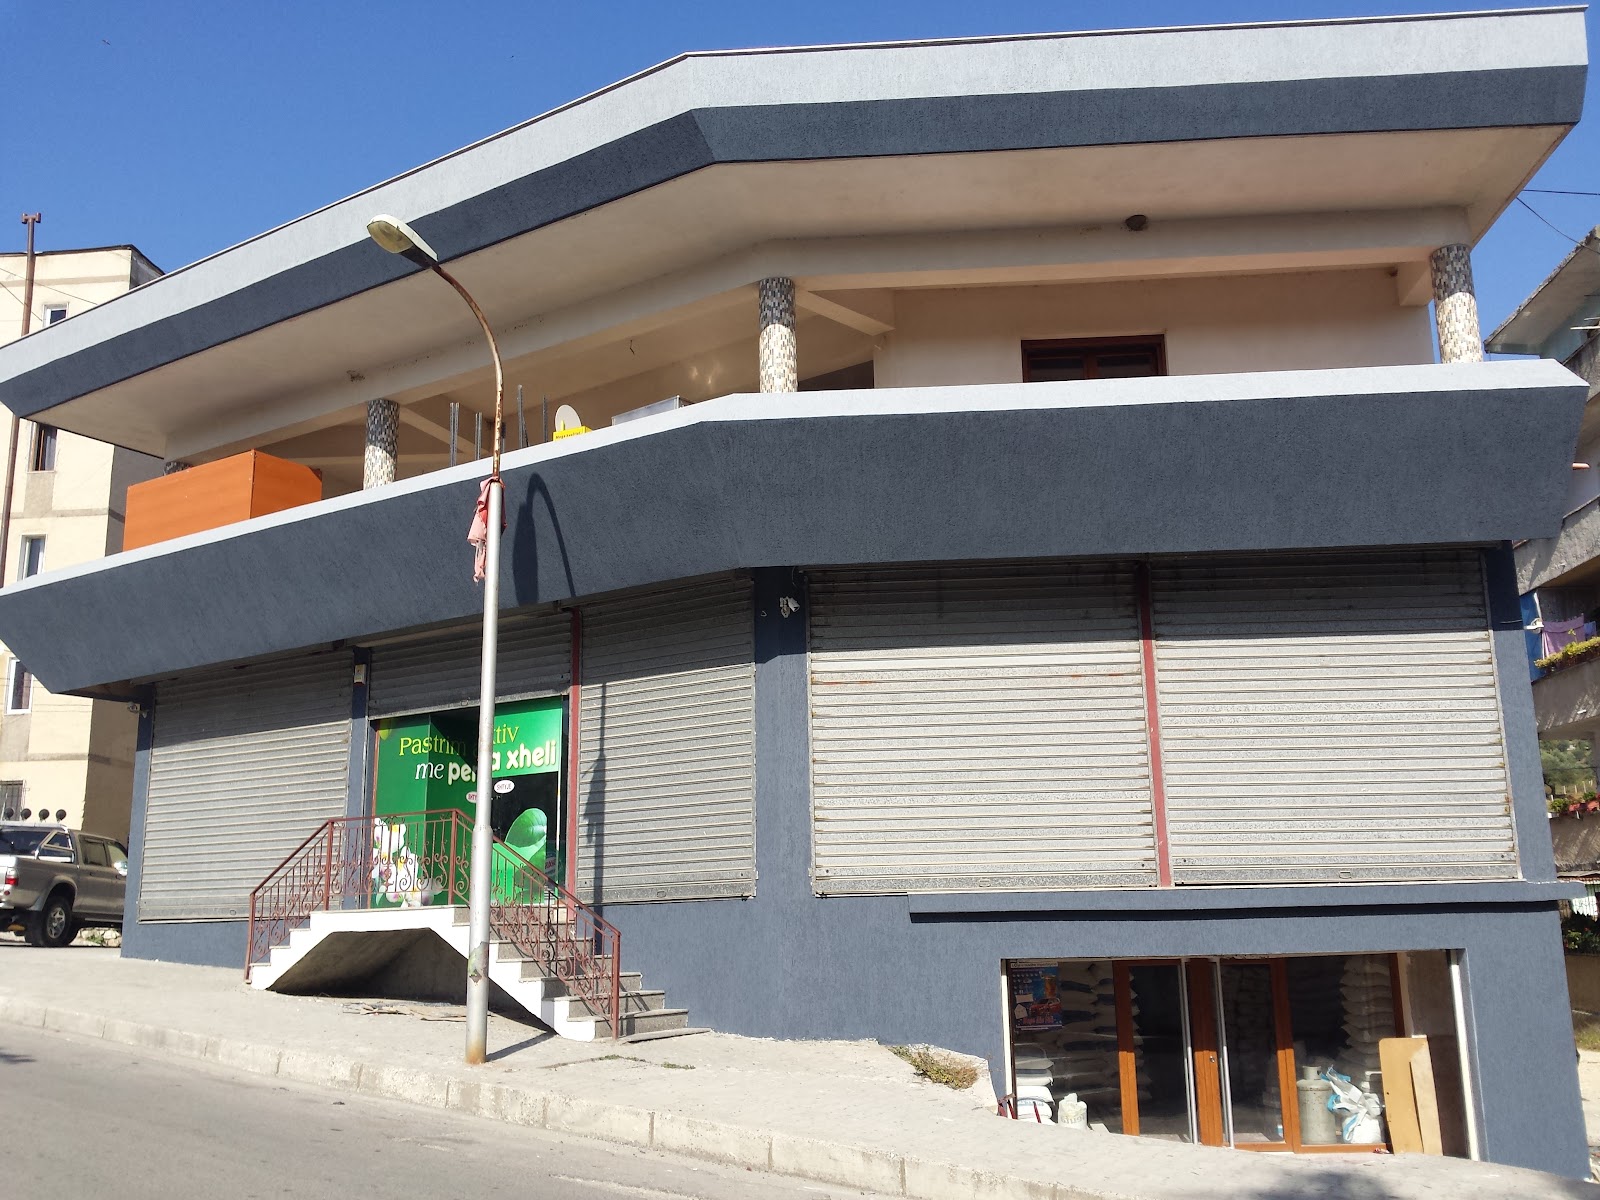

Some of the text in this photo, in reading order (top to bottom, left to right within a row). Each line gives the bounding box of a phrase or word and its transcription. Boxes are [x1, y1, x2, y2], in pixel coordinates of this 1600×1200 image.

[399, 734, 466, 756] Pastrim
[415, 739, 557, 785] me pera xheli
